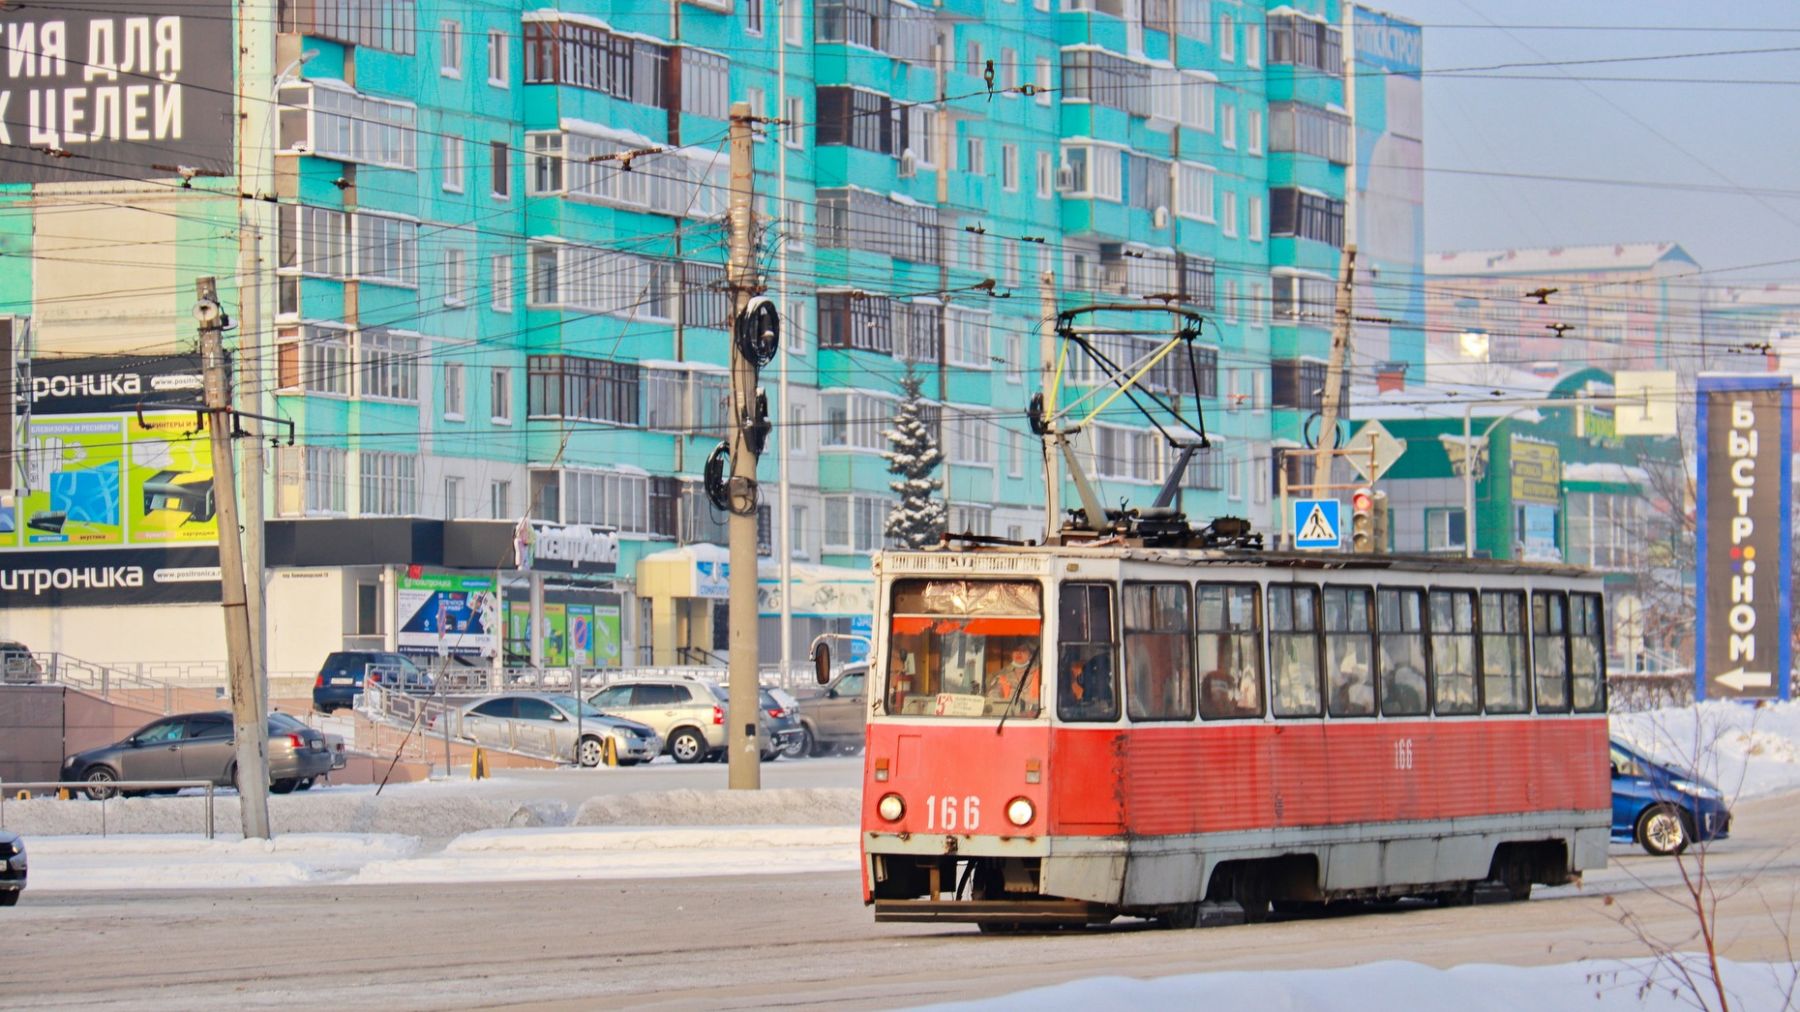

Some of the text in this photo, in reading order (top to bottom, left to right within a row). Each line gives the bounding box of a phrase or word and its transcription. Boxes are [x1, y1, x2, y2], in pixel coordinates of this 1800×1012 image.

[0, 16, 181, 81] ИЯ ДЛЯ
[29, 73, 182, 150] ЦЕЛЕЙ
[30, 373, 141, 402] роника
[1393, 738, 1413, 769] 166
[926, 795, 980, 830] 166
